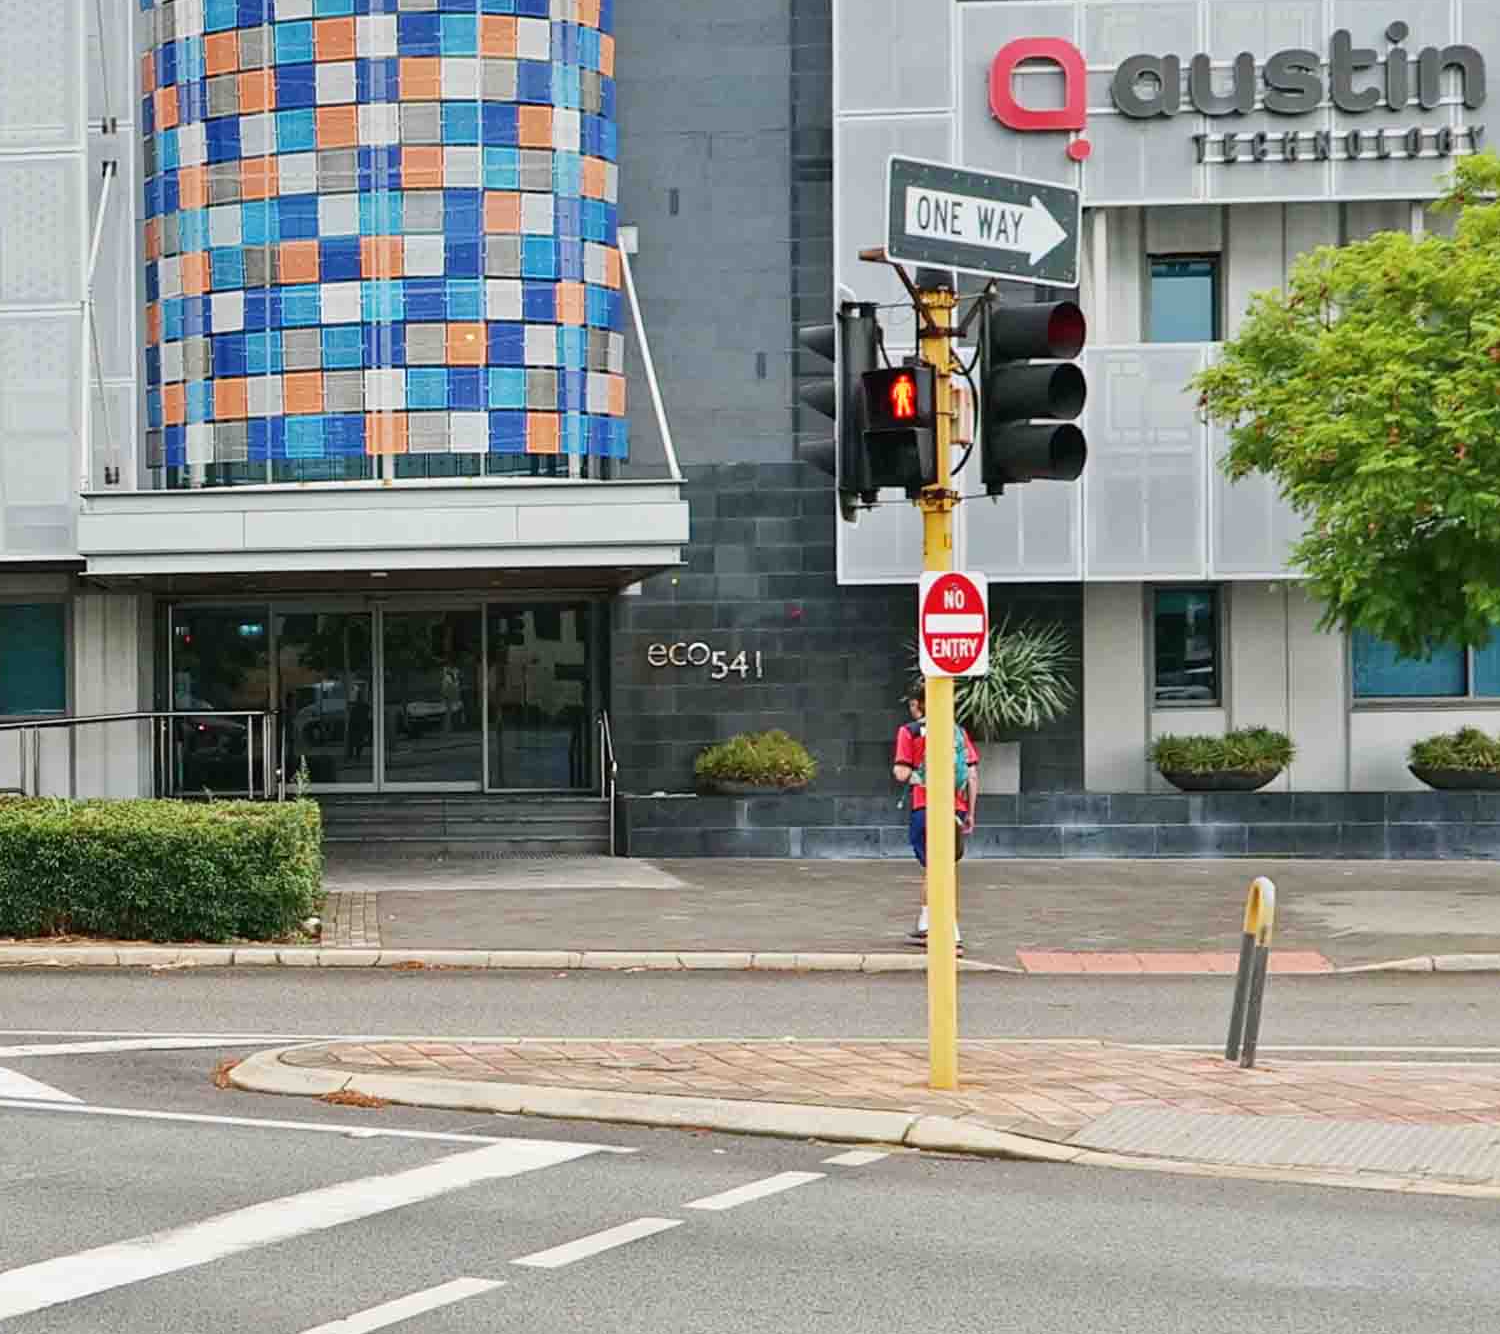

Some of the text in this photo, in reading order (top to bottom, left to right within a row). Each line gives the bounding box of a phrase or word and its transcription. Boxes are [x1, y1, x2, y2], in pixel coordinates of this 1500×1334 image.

[1111, 20, 1487, 118] austin
[1191, 125, 1485, 164] TECHNOLOGY
[917, 196, 1024, 244] ONE WAY
[943, 590, 966, 609] NO
[931, 638, 979, 658] ENTRY
